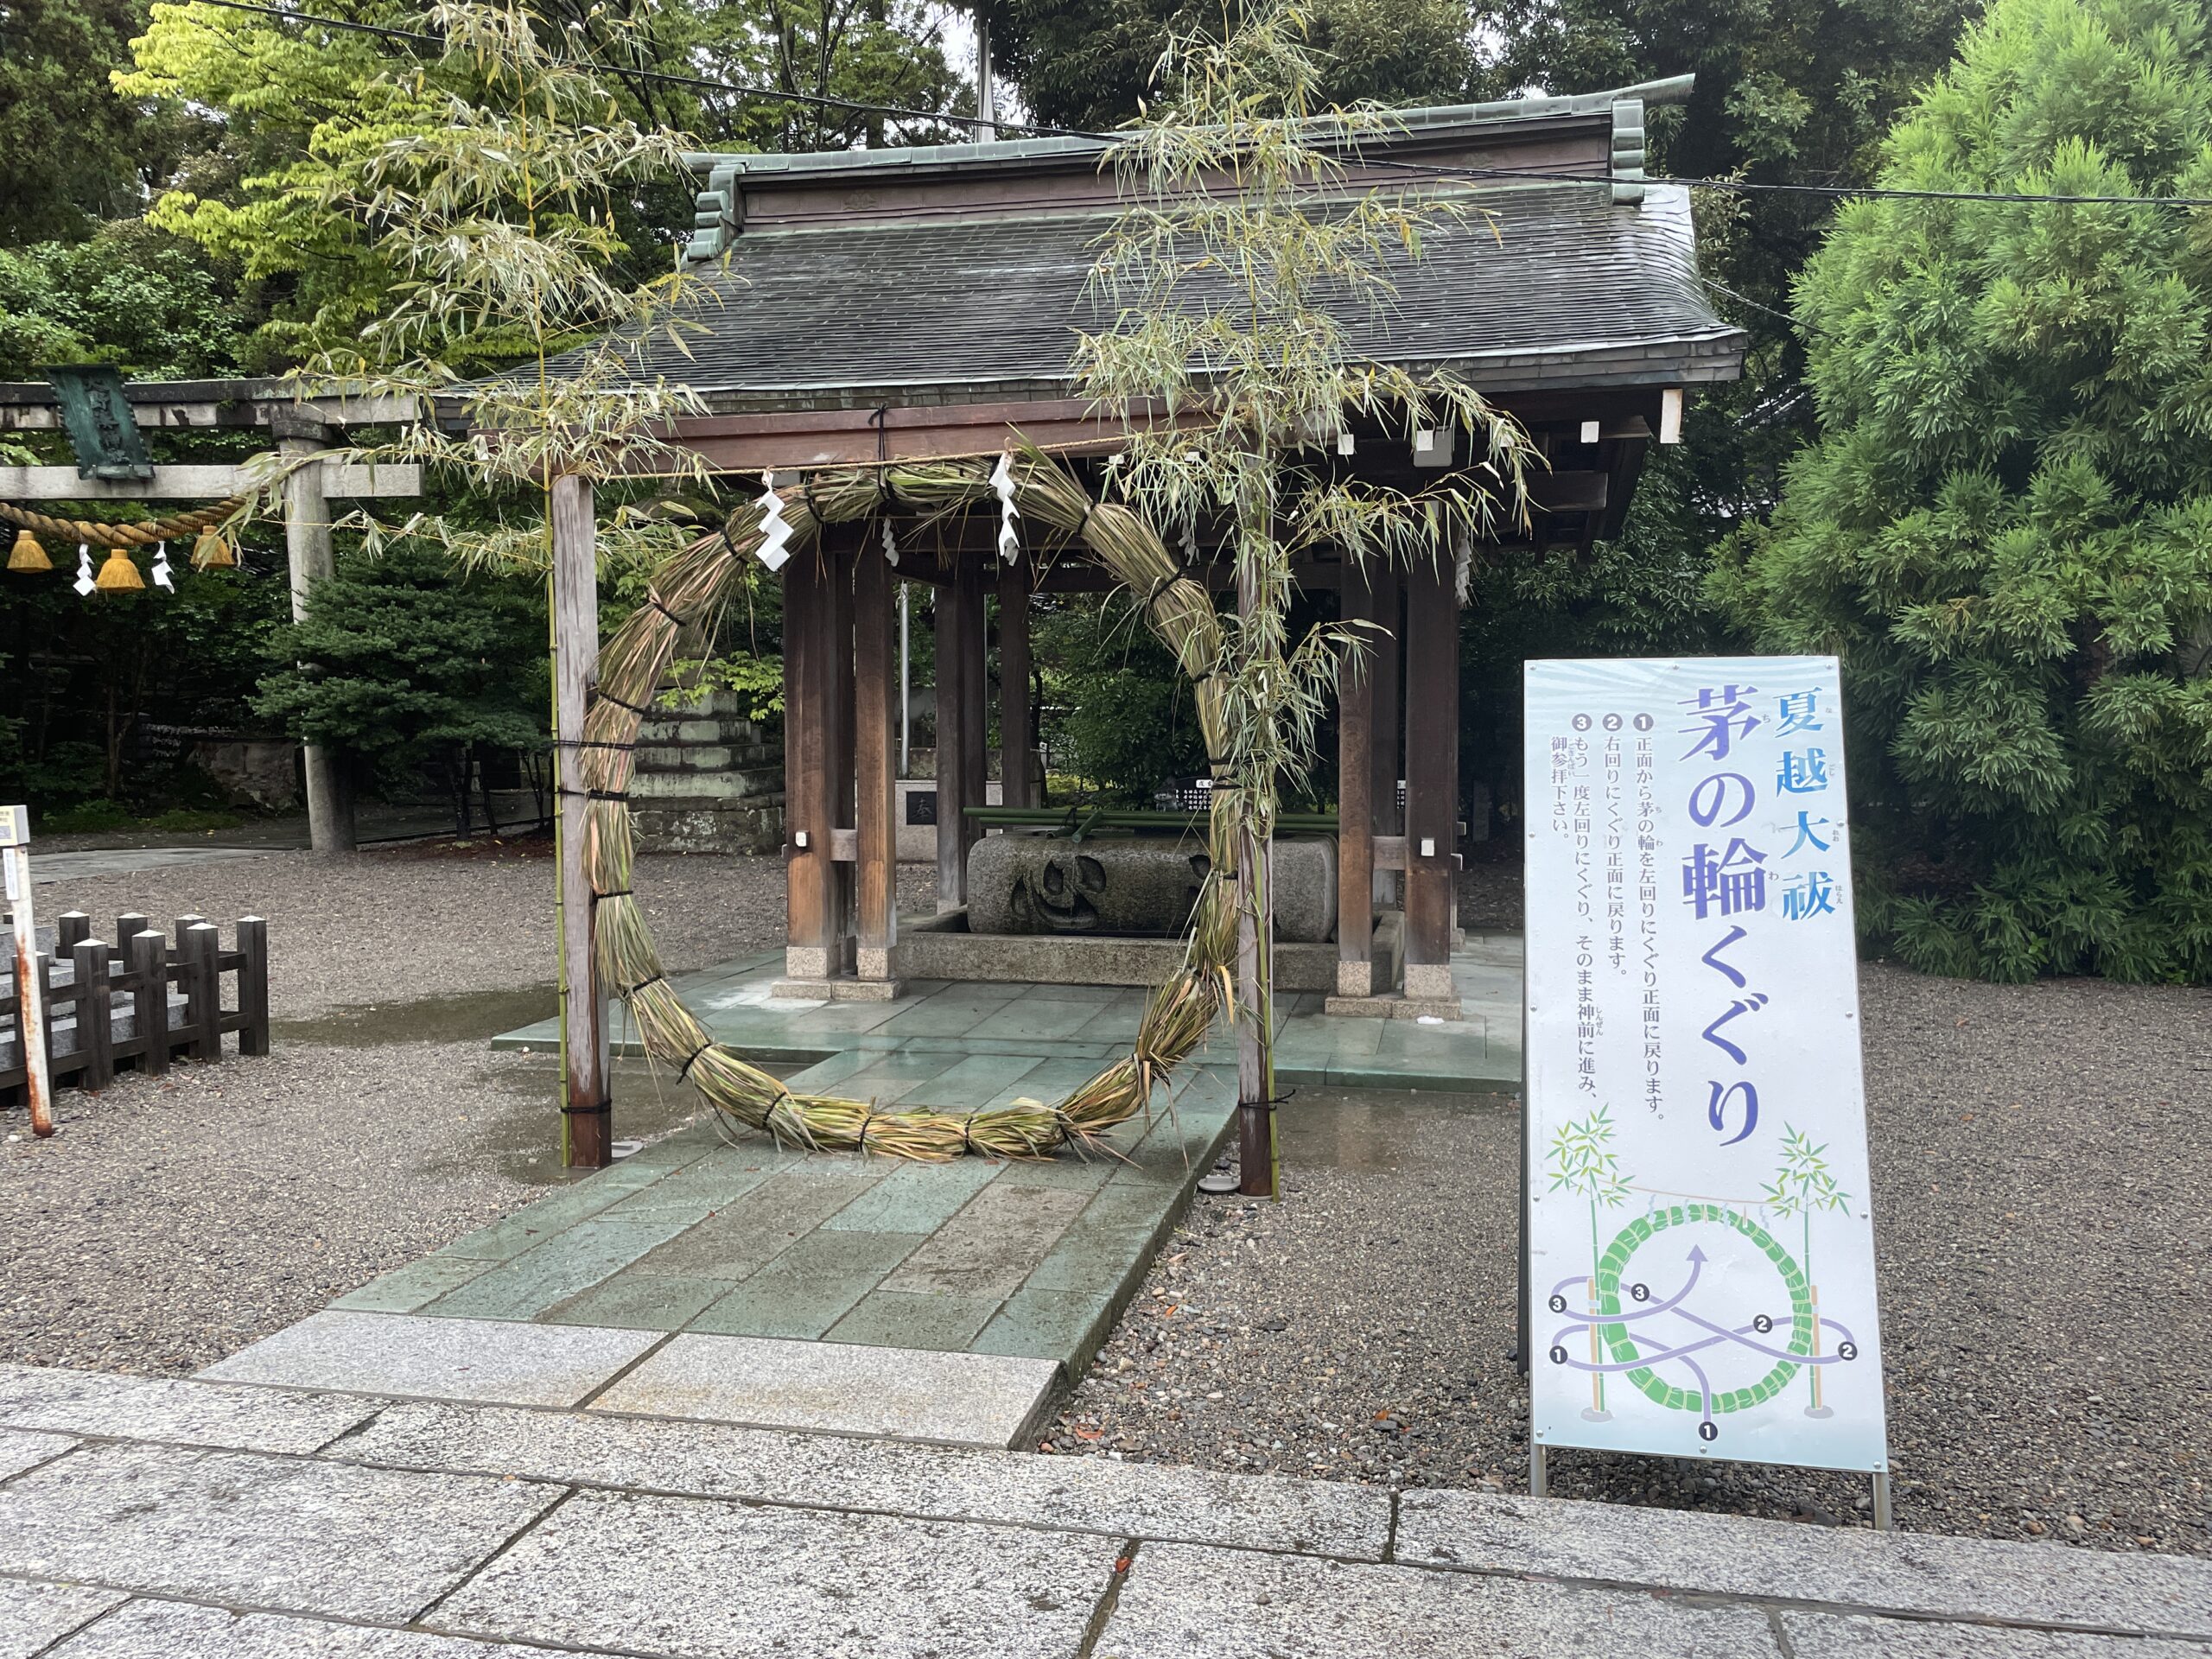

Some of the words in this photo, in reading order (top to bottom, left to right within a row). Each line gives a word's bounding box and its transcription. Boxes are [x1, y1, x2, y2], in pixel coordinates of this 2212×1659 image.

[1677, 684, 1769, 1147] 茅の輪くぐり
[1772, 686, 1835, 921] 夏越大祓
